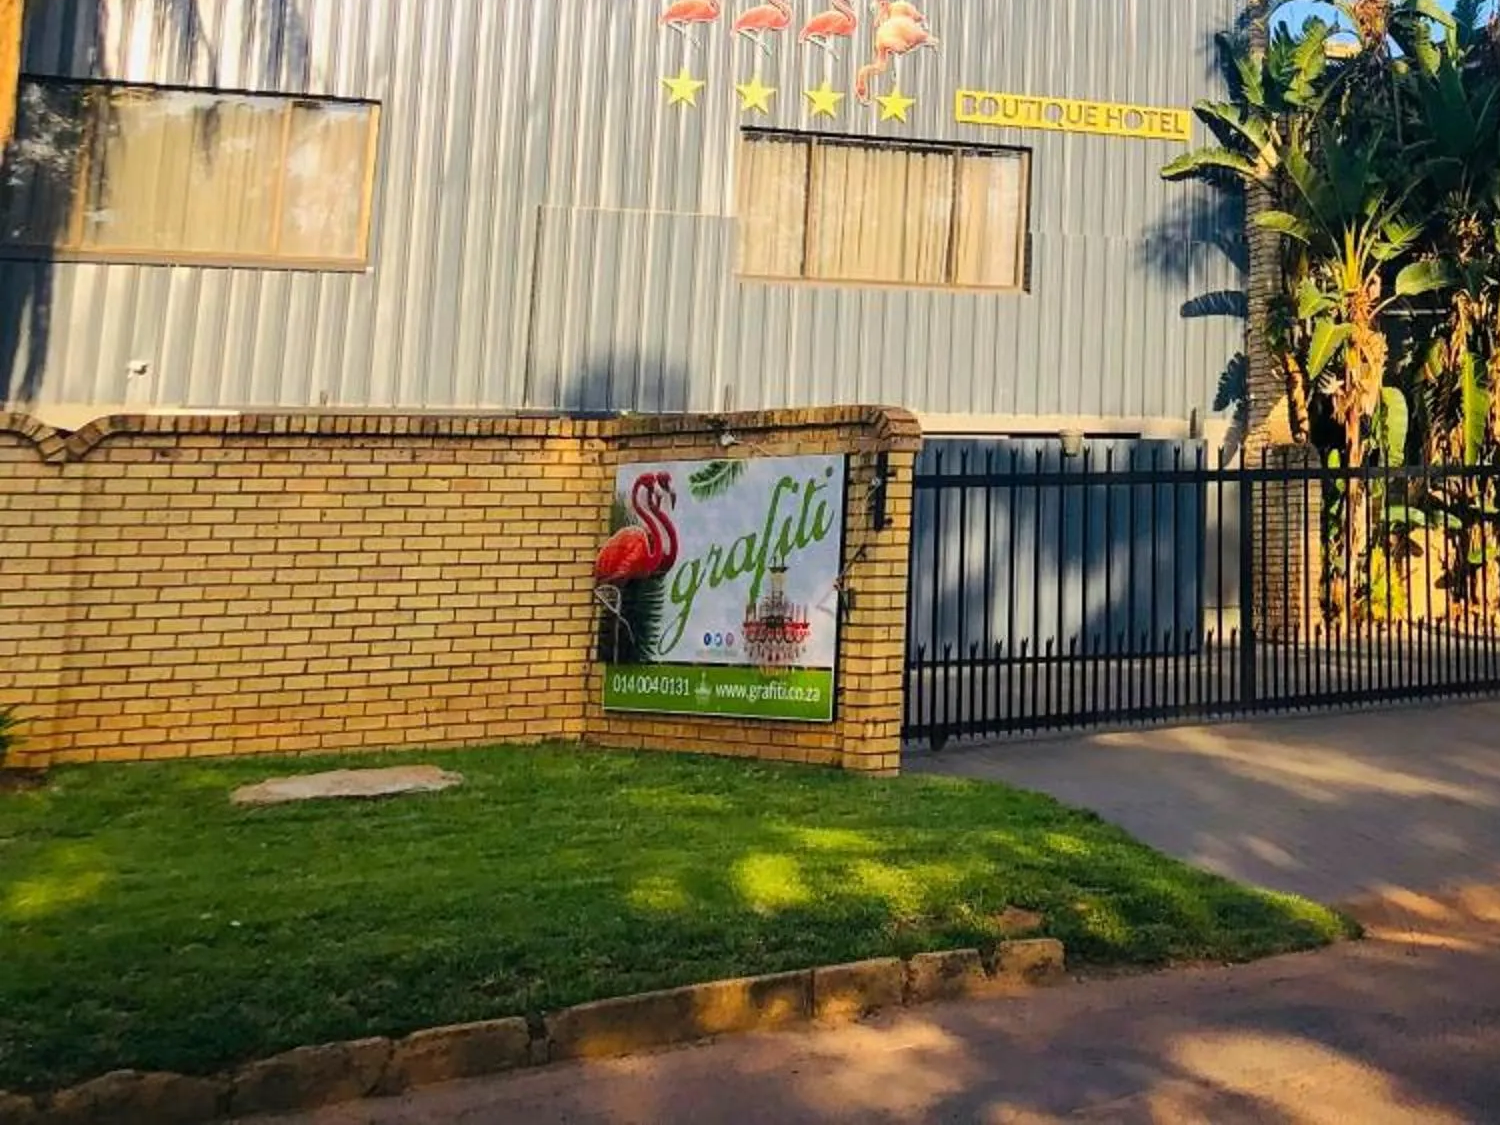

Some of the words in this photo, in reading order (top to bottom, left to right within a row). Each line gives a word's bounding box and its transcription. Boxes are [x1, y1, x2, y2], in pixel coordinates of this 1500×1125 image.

[961, 93, 1098, 127] BOUTIQUE
[1105, 107, 1186, 135] HOTEL
[658, 465, 834, 656] grafiti
[715, 680, 820, 704] www.grafiti.co.za
